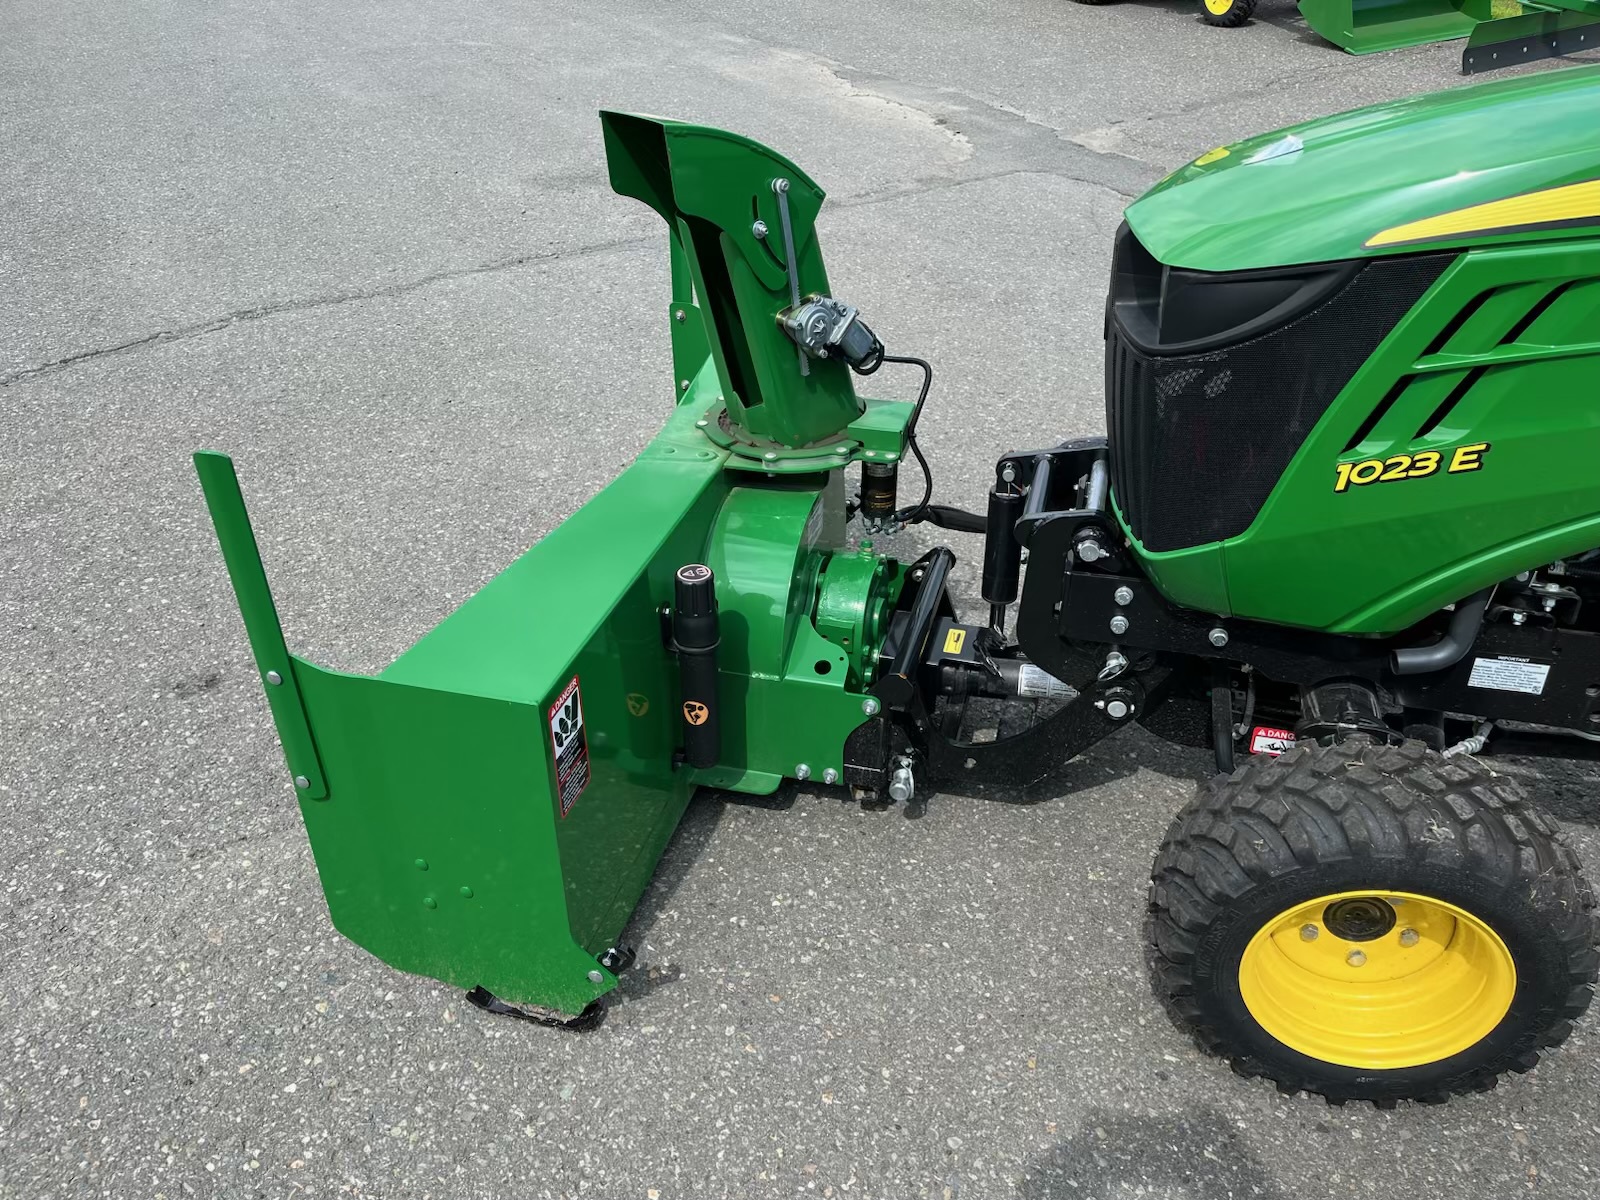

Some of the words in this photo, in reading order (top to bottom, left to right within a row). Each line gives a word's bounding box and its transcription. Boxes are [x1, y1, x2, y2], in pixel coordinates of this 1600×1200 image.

[1334, 451, 1443, 492] 1023
[1448, 442, 1490, 474] E
[1497, 655, 1530, 663] IMPORTANT
[555, 678, 577, 709] DANGER
[1267, 729, 1296, 740] DANG
